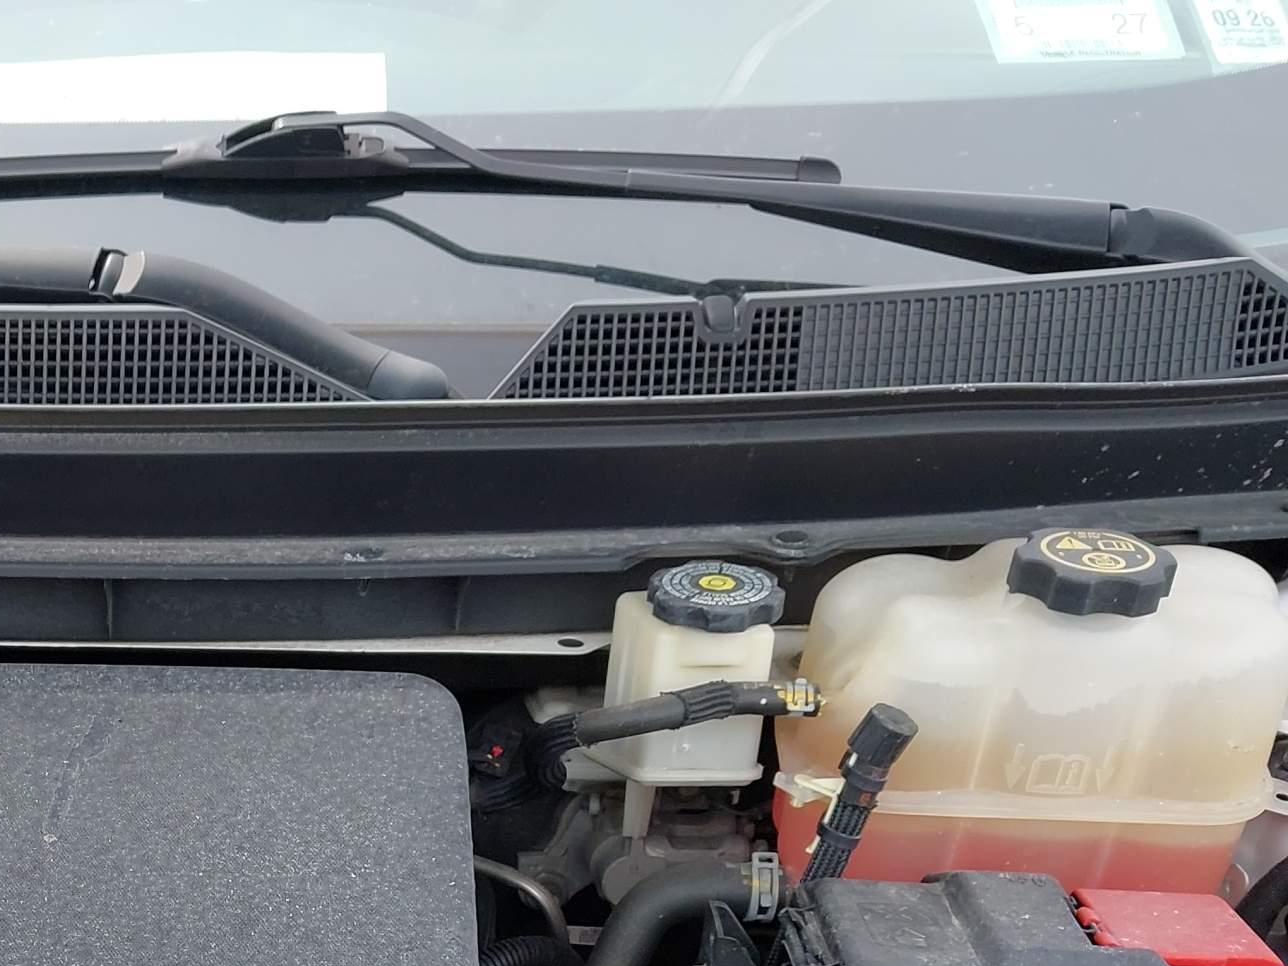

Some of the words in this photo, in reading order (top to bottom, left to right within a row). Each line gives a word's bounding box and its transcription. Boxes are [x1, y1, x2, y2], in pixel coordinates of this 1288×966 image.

[1111, 13, 1147, 35] 27
[1212, 9, 1240, 26] 09
[1247, 9, 1275, 27] 26
